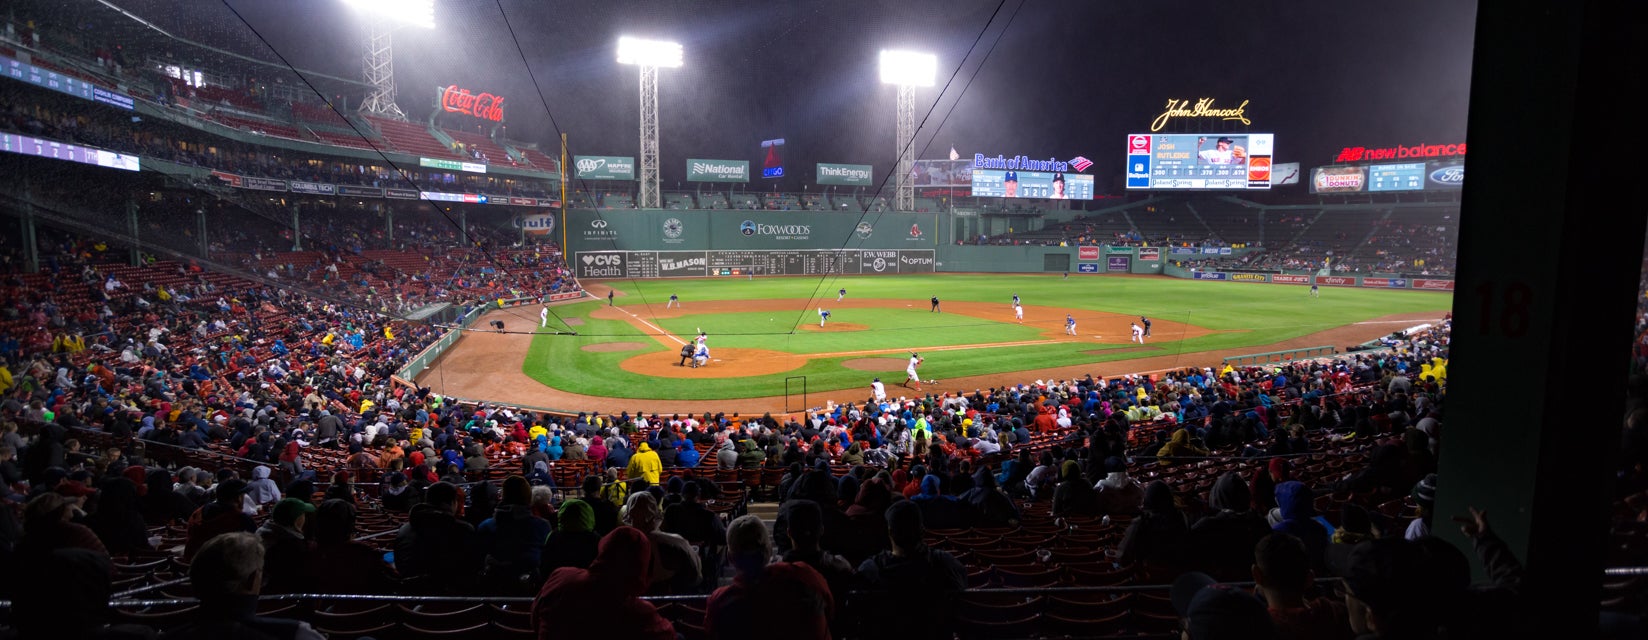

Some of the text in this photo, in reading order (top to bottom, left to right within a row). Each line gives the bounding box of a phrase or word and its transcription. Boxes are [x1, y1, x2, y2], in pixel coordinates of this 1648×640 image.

[442, 85, 505, 123] Coca-Cola
[1151, 97, 1252, 132] John Hancock
[1157, 143, 1175, 151] JOSH
[1365, 149, 1397, 160] new
[1398, 143, 1467, 159] balance
[704, 163, 745, 174] National
[974, 153, 1068, 172] Bank of America
[763, 167, 783, 177] CITGO
[820, 166, 869, 179] ThinkEnergy
[1023, 188, 1029, 197] 3
[1032, 188, 1038, 197] 2
[515, 215, 553, 228] Gulf
[757, 223, 810, 235] FOXWOODS
[595, 254, 621, 265] CVS
[584, 266, 622, 277] Health
[1325, 277, 1345, 285] xfinity
[1475, 281, 1534, 339] 18
